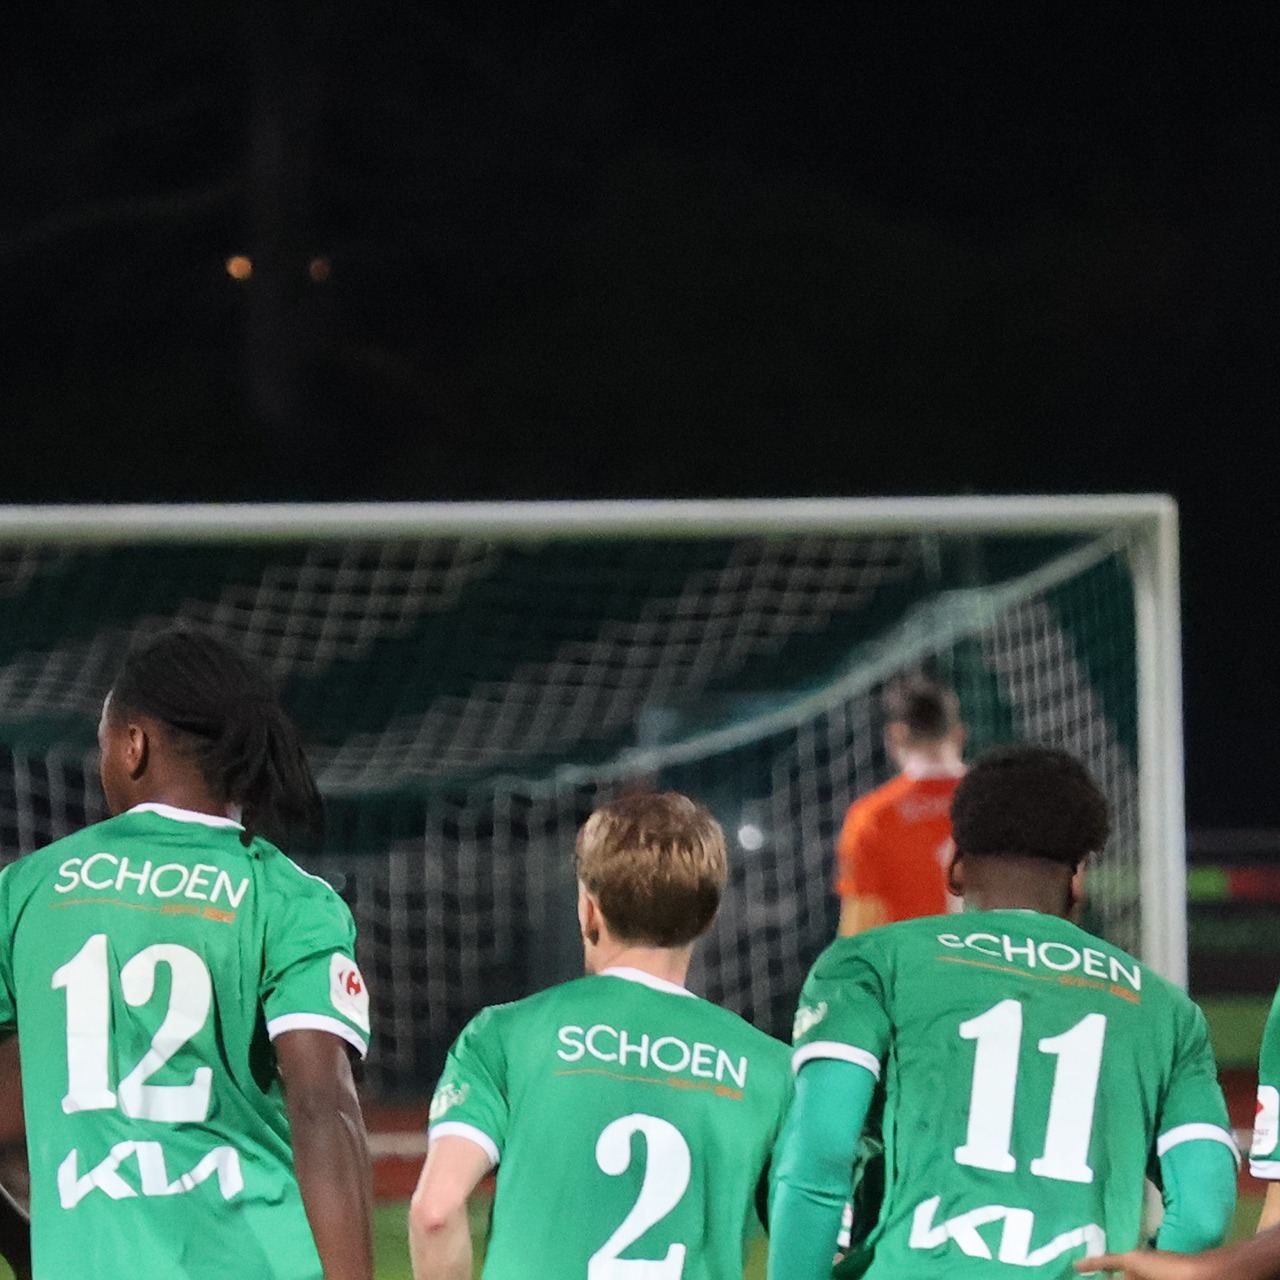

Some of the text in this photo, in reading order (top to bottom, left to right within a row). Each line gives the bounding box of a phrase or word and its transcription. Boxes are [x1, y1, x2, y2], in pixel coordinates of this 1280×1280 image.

[53, 852, 251, 909] SCHOEN
[51, 933, 214, 1123] 12
[556, 1023, 748, 1089] SCHOEN
[953, 998, 1108, 1184] 11
